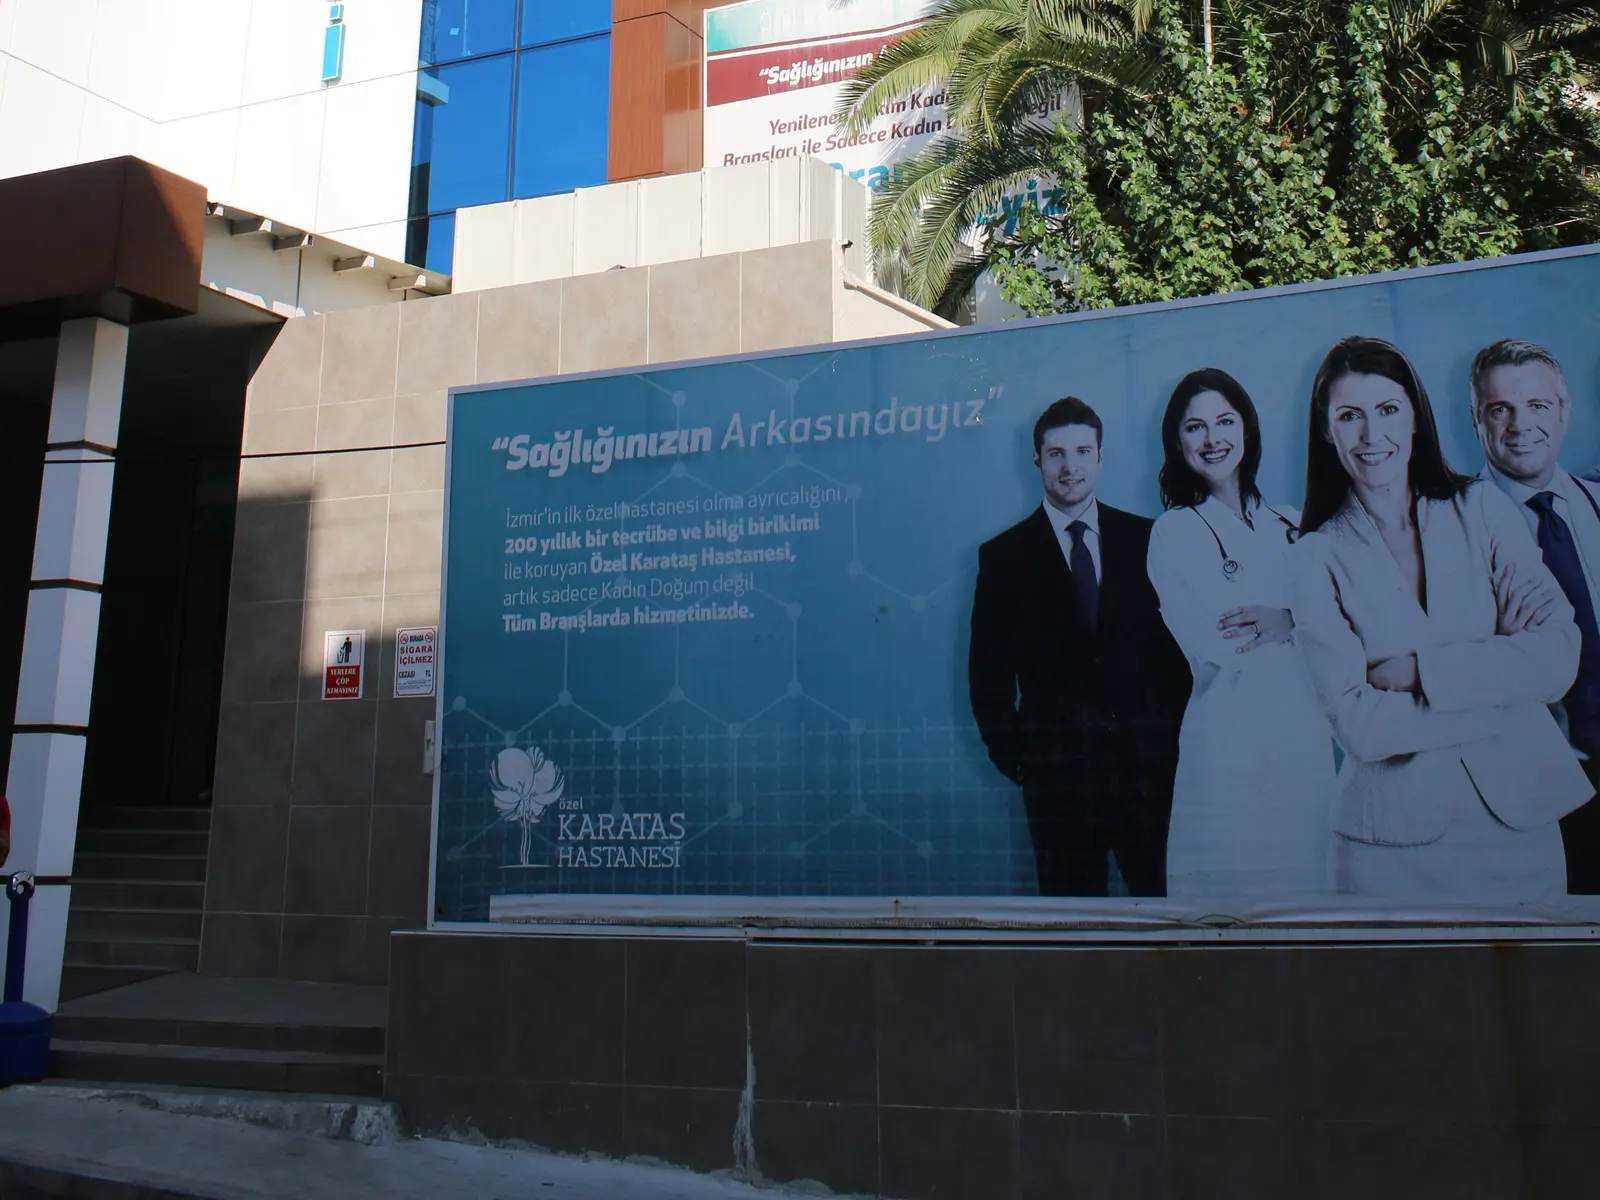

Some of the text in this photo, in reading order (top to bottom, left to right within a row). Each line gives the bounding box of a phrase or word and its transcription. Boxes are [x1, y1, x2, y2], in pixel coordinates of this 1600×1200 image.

[564, 505, 582, 524] ilk
[585, 502, 618, 522] özel
[621, 495, 699, 519] hastanesi
[703, 492, 743, 512] olma
[505, 537, 537, 554] 200
[585, 529, 609, 548] bir
[612, 524, 677, 546] tecrübe
[681, 526, 701, 540] ve
[705, 517, 744, 542] bilgi
[748, 510, 820, 535] birikimi
[504, 541, 796, 581] ile koruyan Özel Karataş Hastanesi,
[542, 584, 598, 604] sadece
[651, 575, 708, 600] Doğum
[713, 571, 754, 597] değil
[502, 601, 755, 633] Tüm Branşlarda hizmetinizde.
[400, 645, 433, 654] SİGARA
[559, 797, 583, 810] özel
[558, 840, 680, 868] HASTANESİ
